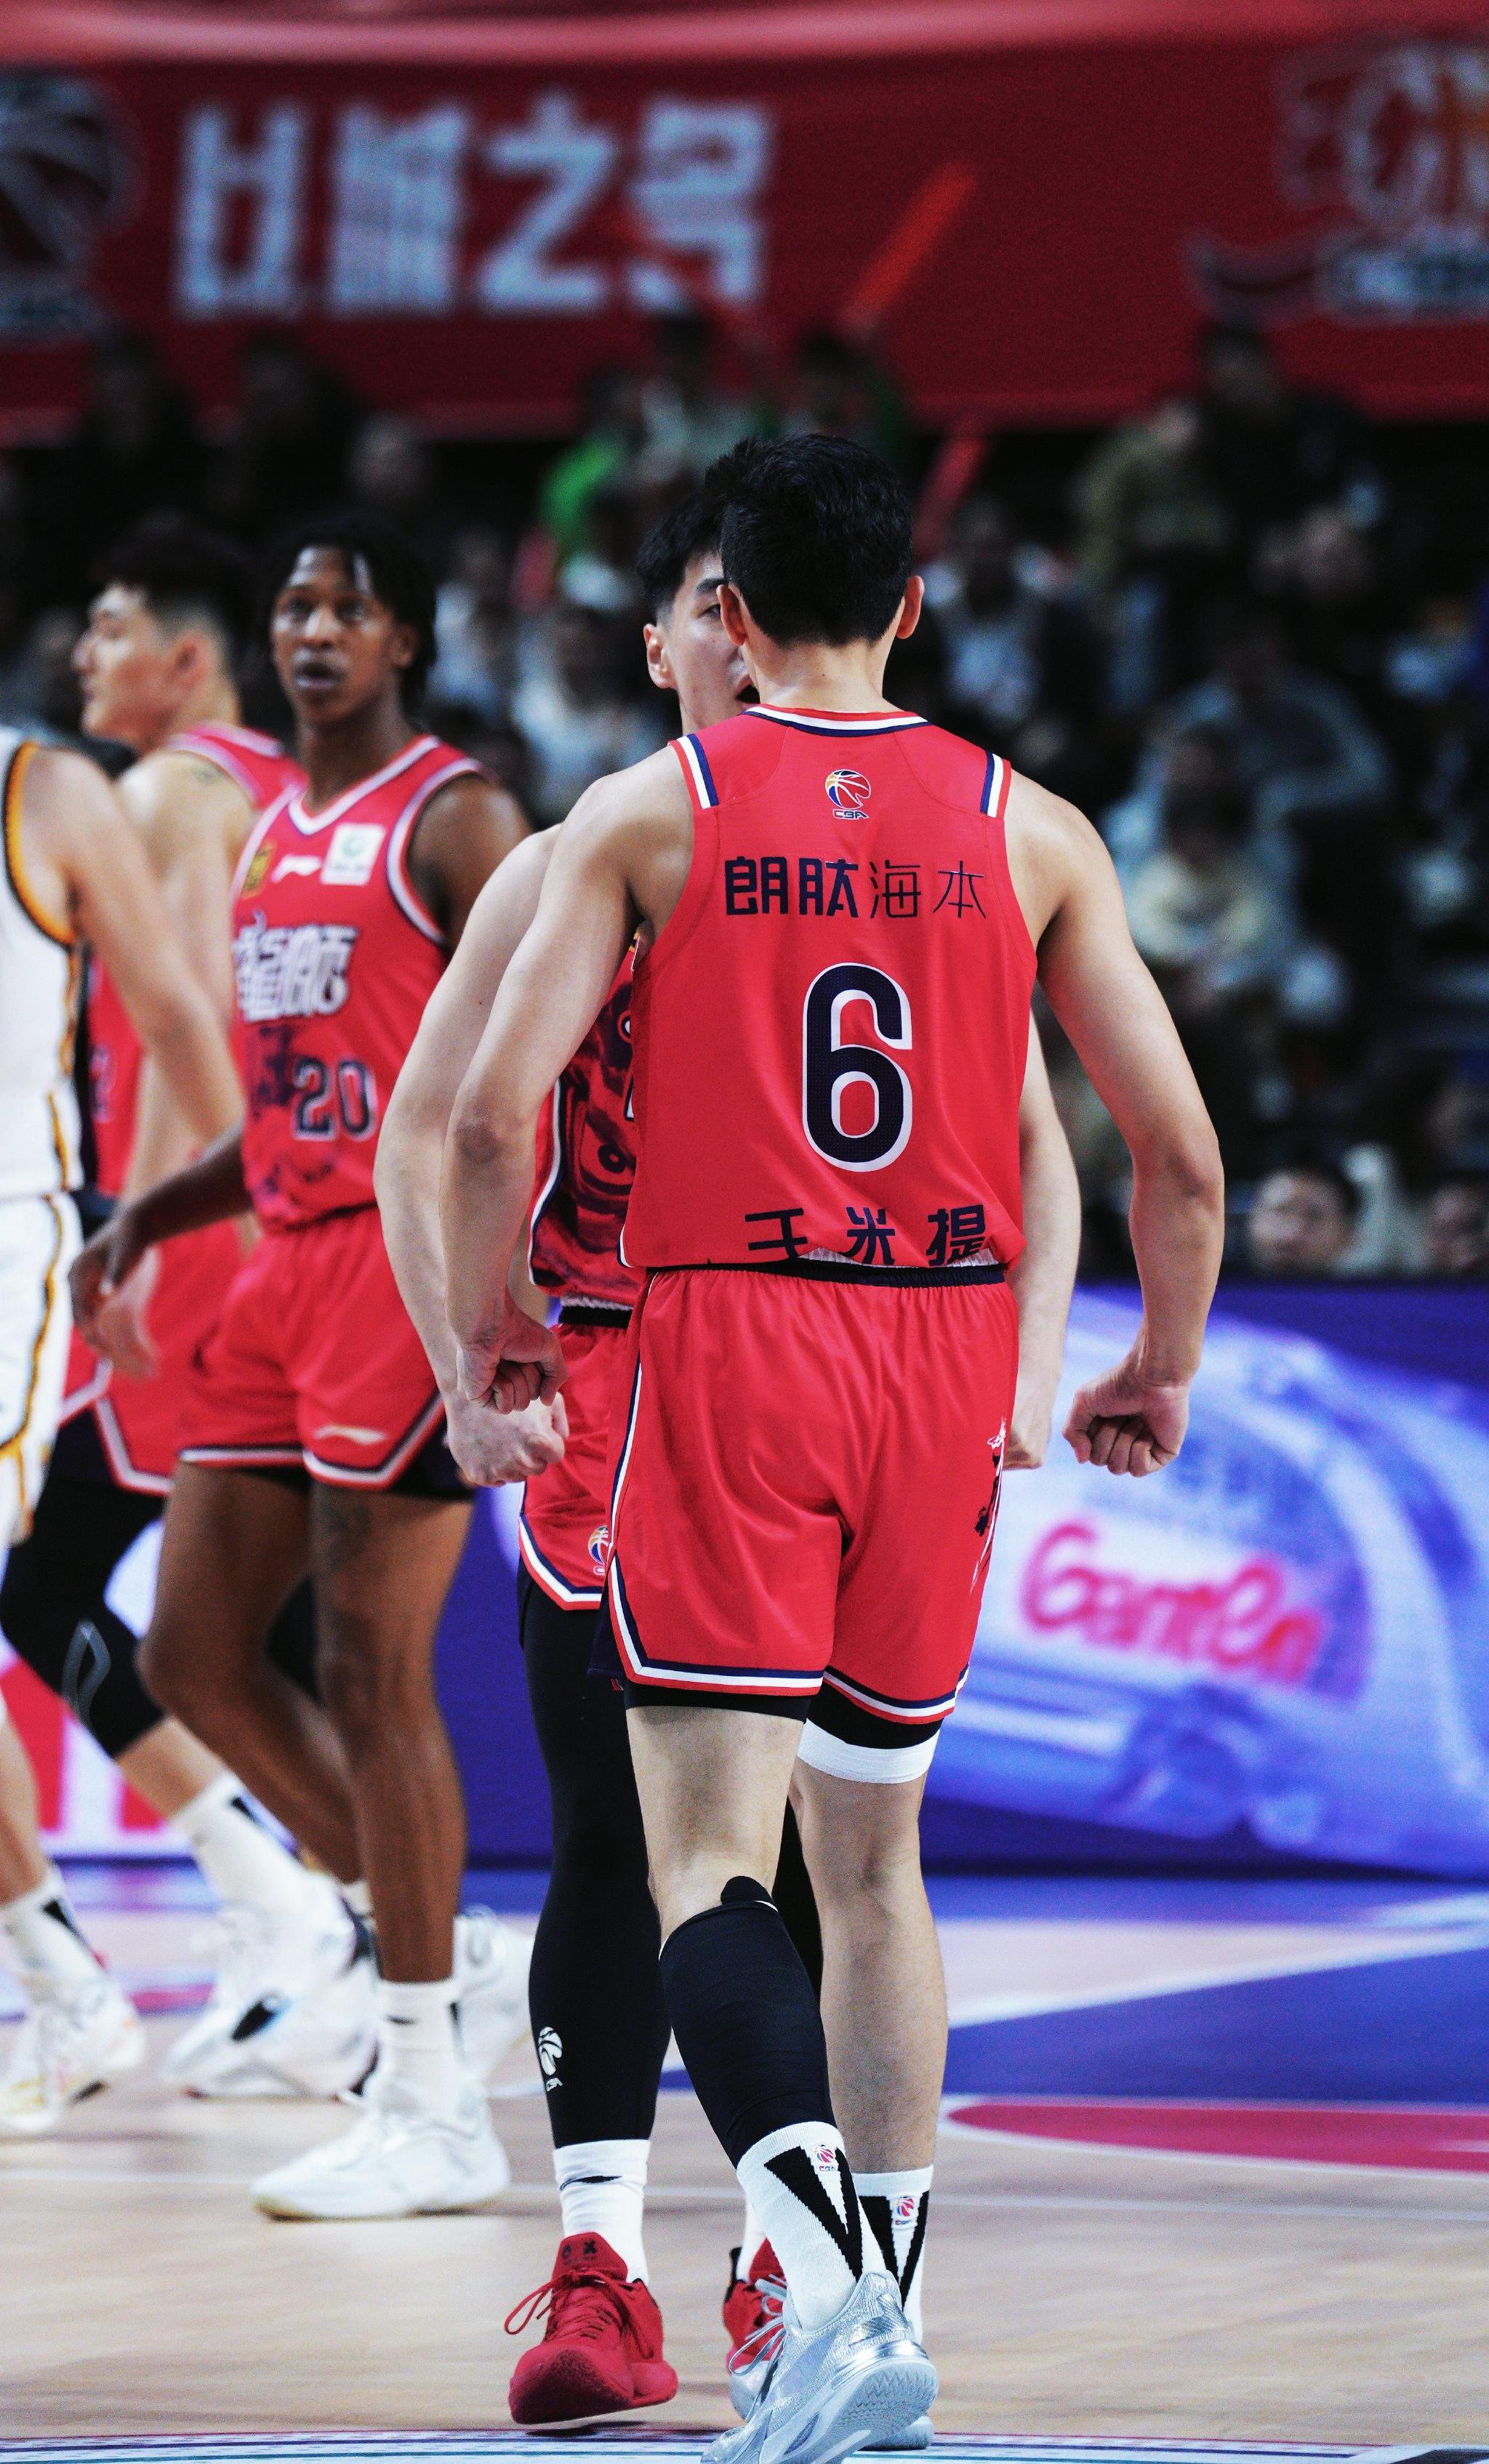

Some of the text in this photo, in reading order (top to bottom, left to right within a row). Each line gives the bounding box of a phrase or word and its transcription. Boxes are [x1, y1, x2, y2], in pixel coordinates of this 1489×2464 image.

[832, 808, 870, 820] CBA
[725, 856, 987, 919] 朗肽海本
[293, 1055, 377, 1142] 20
[802, 962, 913, 1172] 6
